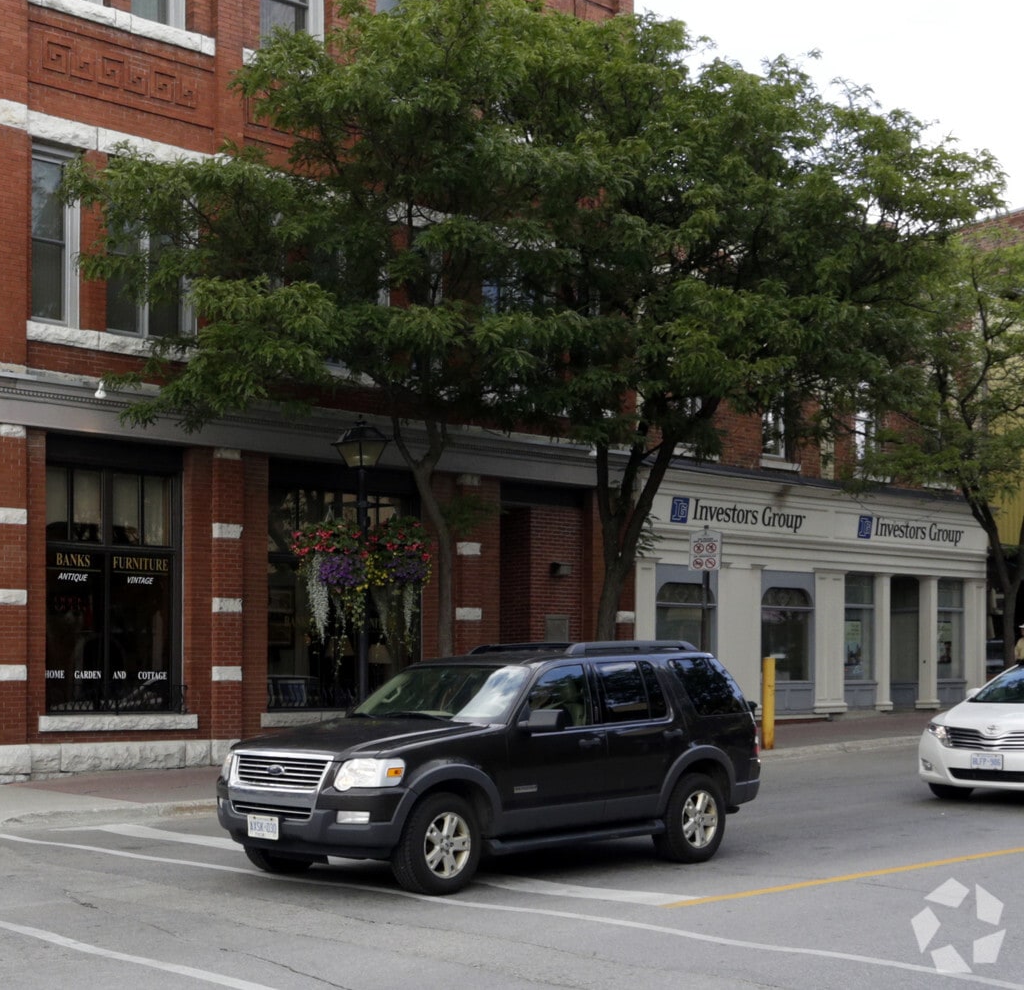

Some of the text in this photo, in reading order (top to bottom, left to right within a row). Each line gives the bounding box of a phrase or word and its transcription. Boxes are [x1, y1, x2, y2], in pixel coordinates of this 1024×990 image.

[692, 498, 759, 525] Investors
[762, 506, 803, 533] Group
[874, 517, 927, 540] Investors
[929, 523, 962, 546] Group
[56, 553, 169, 572] BANKS FURNITURE
[58, 572, 155, 585] ANTIQUE VINTAGE
[45, 670, 167, 680] HOME GARDEN AND COTTAGE
